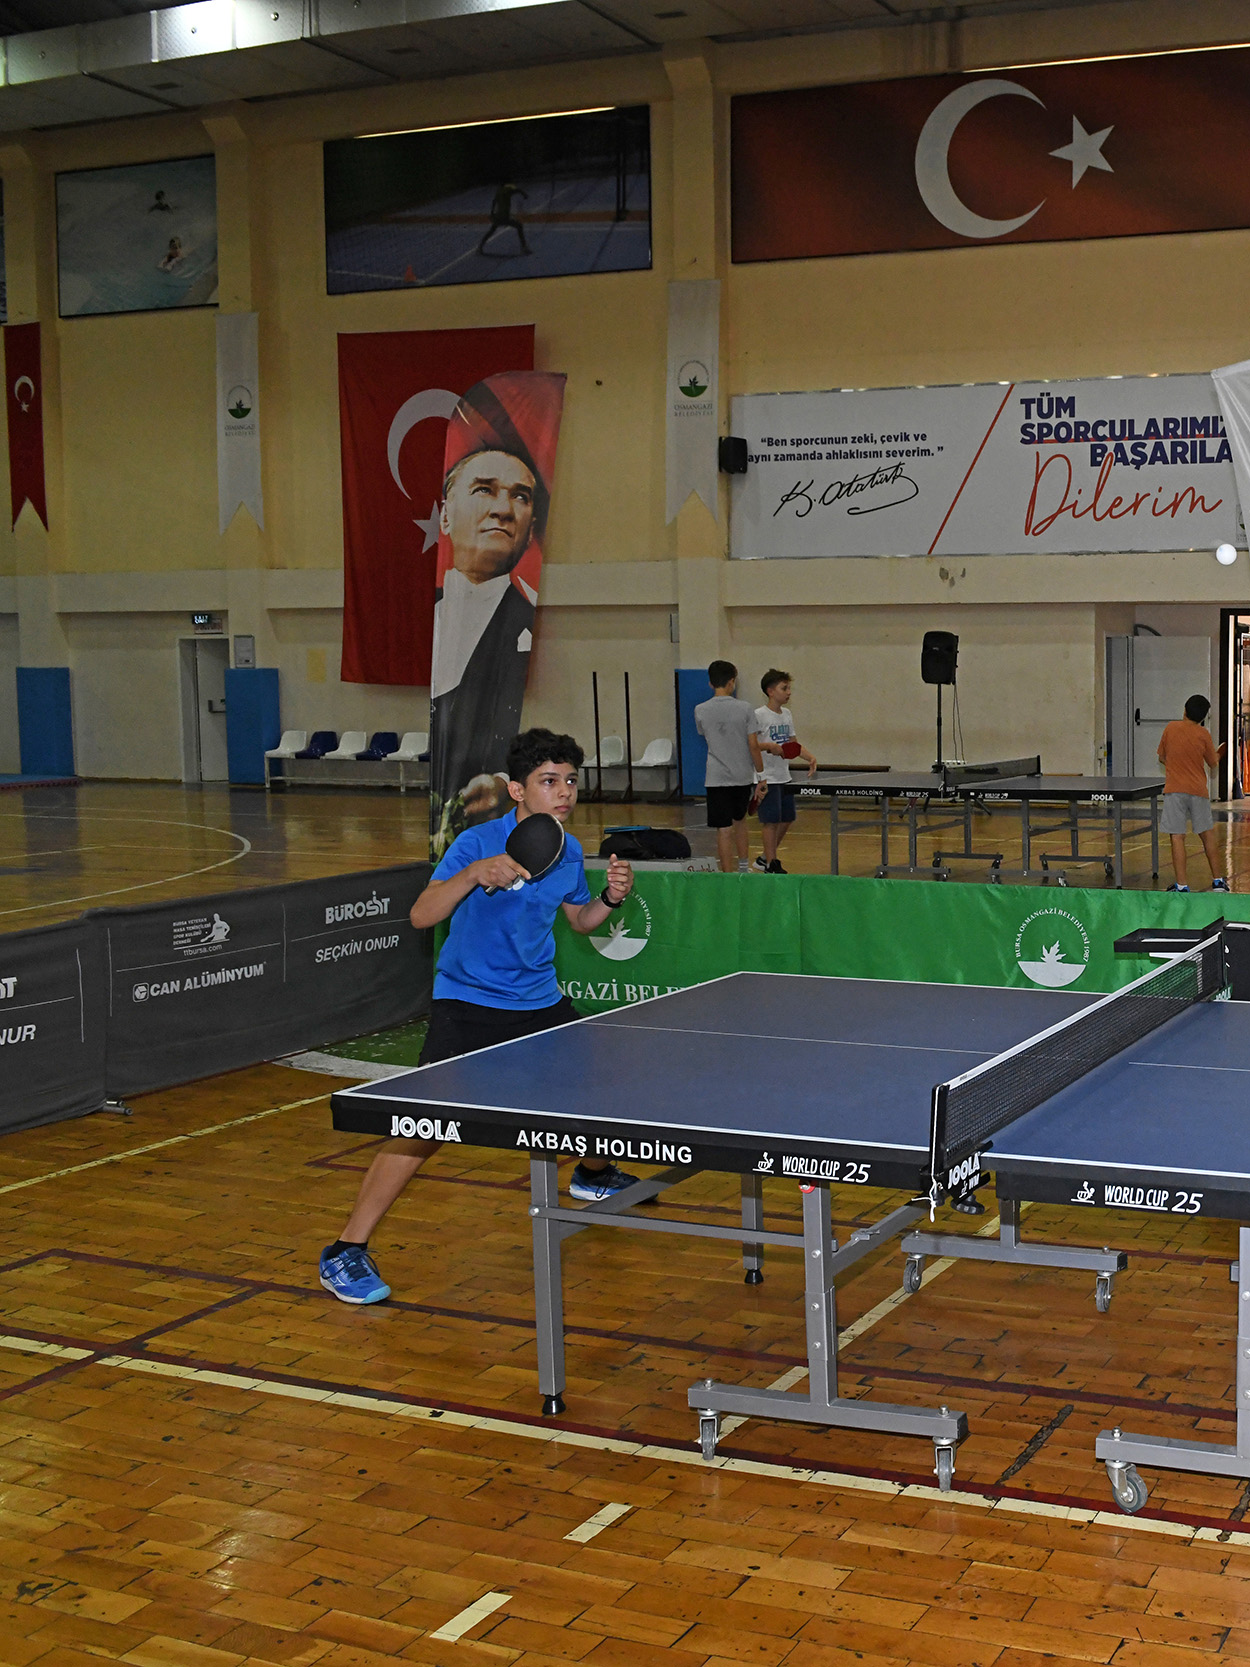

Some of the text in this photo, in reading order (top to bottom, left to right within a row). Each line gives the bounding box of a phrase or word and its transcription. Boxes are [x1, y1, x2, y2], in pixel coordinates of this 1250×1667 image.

[1020, 392, 1075, 419] TÜM
[748, 453, 771, 464] aynı
[773, 450, 823, 462] zamanda
[826, 449, 883, 461] ahlaklısını
[885, 446, 935, 459] severim.
[790, 436, 848, 449] sporcunun
[851, 433, 877, 446] zeki,
[880, 432, 910, 445] çevik
[913, 433, 927, 443] ve
[1024, 451, 1223, 537] Dilerim
[315, 935, 399, 963] SEÇKİN ONUR
[150, 963, 265, 997] CAN ALÜMİNYUM
[391, 1115, 461, 1143] JOOLA
[516, 1129, 692, 1164] AKBAŞ HOLDİNG
[782, 1155, 871, 1184] WORLD CUP 25
[948, 1151, 980, 1189] JOOLA
[1104, 1184, 1204, 1214] WORLD CUP 25
